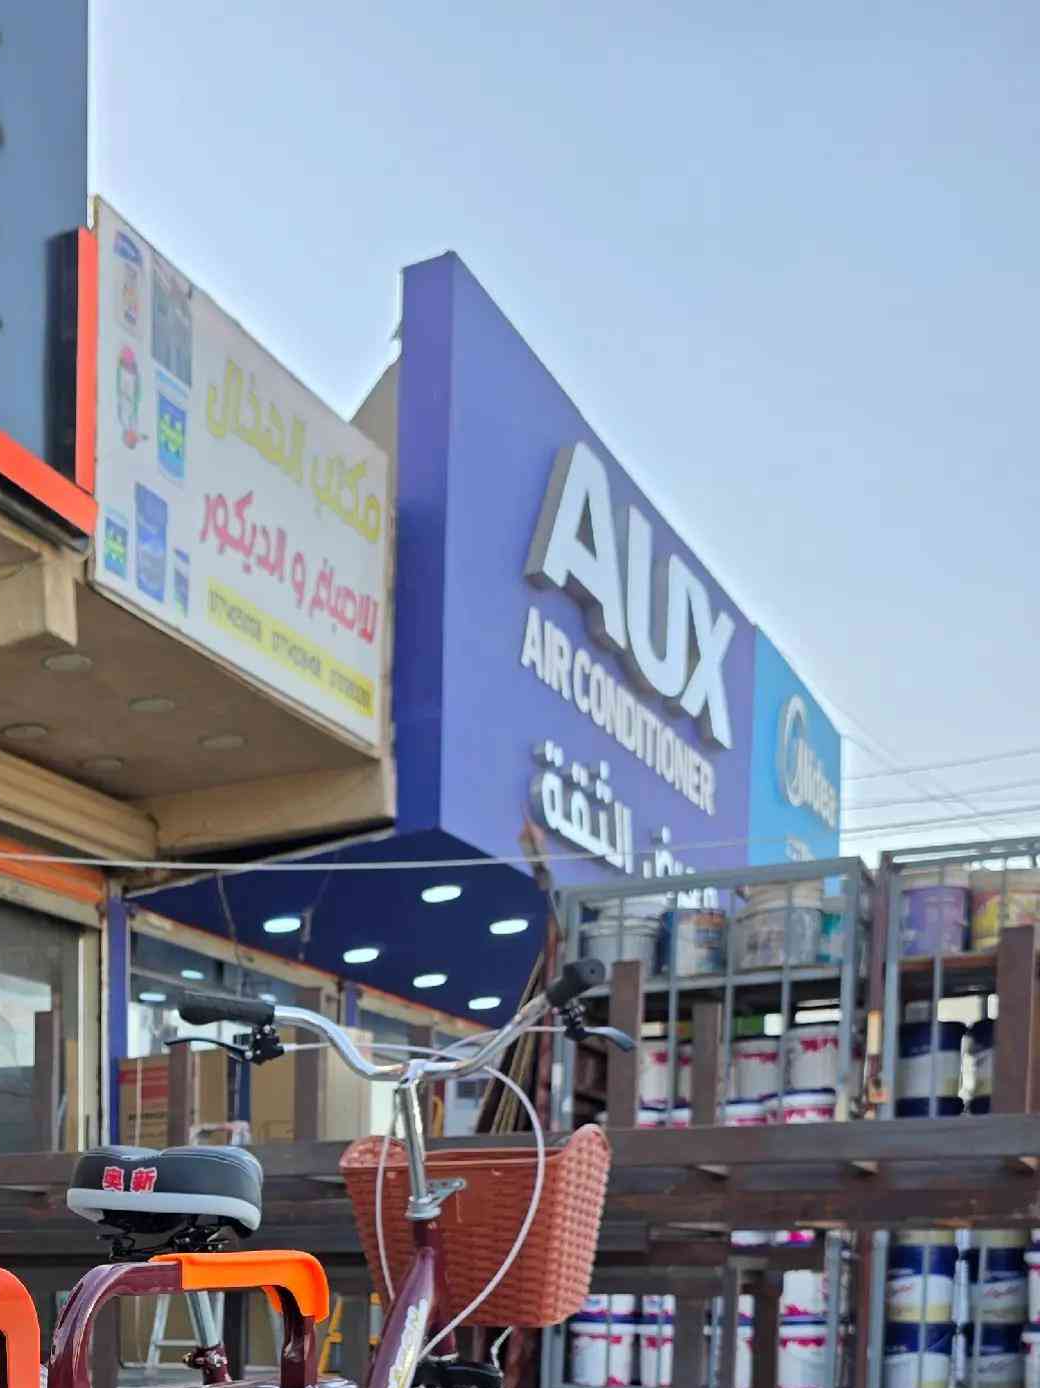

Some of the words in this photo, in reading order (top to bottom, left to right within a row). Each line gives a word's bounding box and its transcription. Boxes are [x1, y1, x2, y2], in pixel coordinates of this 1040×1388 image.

[200, 490, 287, 583] الديكور
[540, 441, 735, 750] AUX
[521, 606, 571, 702] AIR
[572, 649, 715, 816] CONDITIONER
